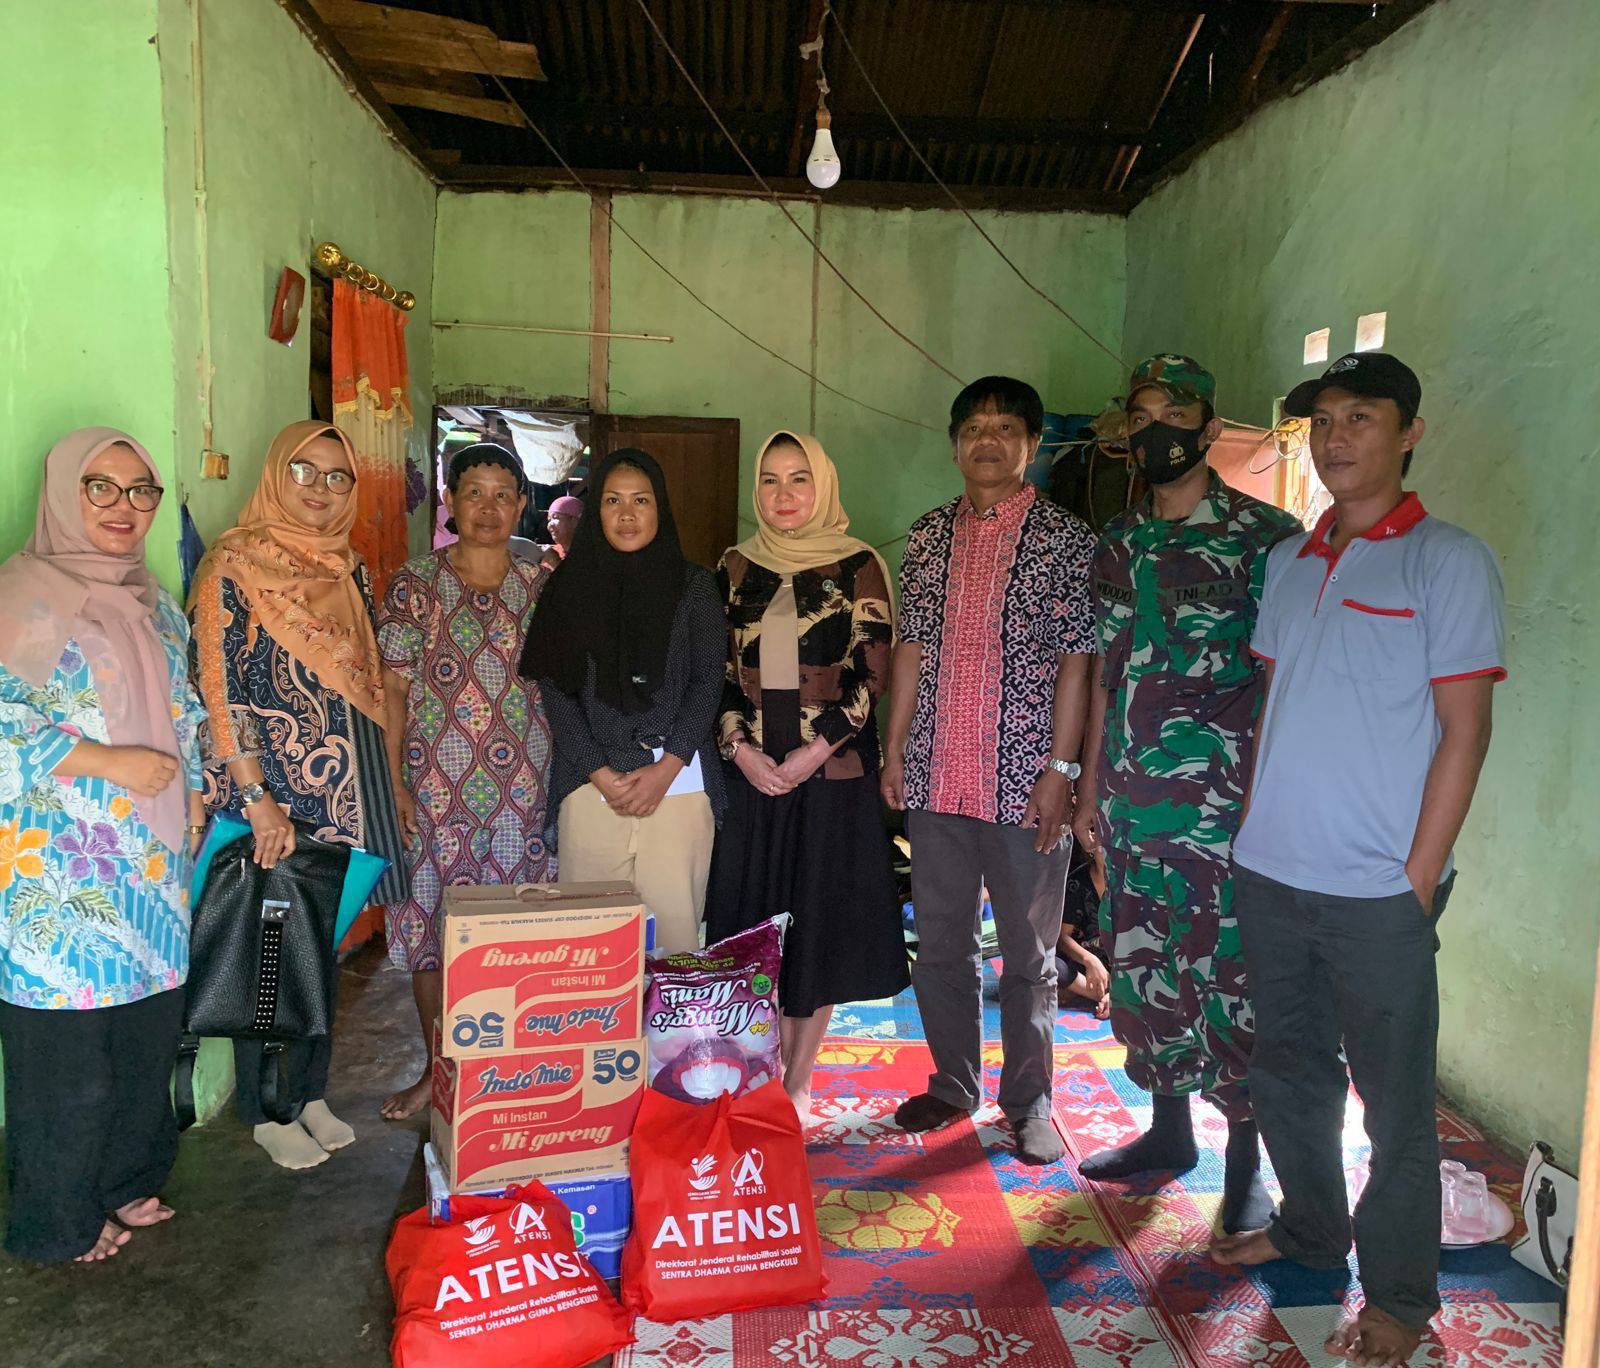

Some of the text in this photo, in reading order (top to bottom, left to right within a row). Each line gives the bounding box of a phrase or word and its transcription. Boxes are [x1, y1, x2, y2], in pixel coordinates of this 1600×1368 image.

[480, 943, 610, 967] Mi goreng
[551, 974, 607, 987] Mi Instan
[651, 999, 770, 1037] Manggis
[493, 1111, 548, 1125] Mi Instan
[489, 1124, 613, 1152] Mi goreng
[557, 1184, 596, 1195] Kemasan
[733, 1186, 767, 1197] ATENSI
[513, 1230, 552, 1245] ATENSI
[651, 1203, 801, 1249] ATENSI
[655, 1245, 802, 1269] Direktorat Jenderal Rehabilitasi Sosial
[661, 1257, 799, 1280] SENTRA DHARMA GUNA BENGKULU
[433, 1251, 590, 1313] ATENSI
[440, 1314, 487, 1330] Direktorat
[488, 1302, 528, 1319] Jenderal
[529, 1288, 578, 1307] Rehabilitasi
[449, 1294, 600, 1340] SENTRA DHARMA GUNA BENGKULU
